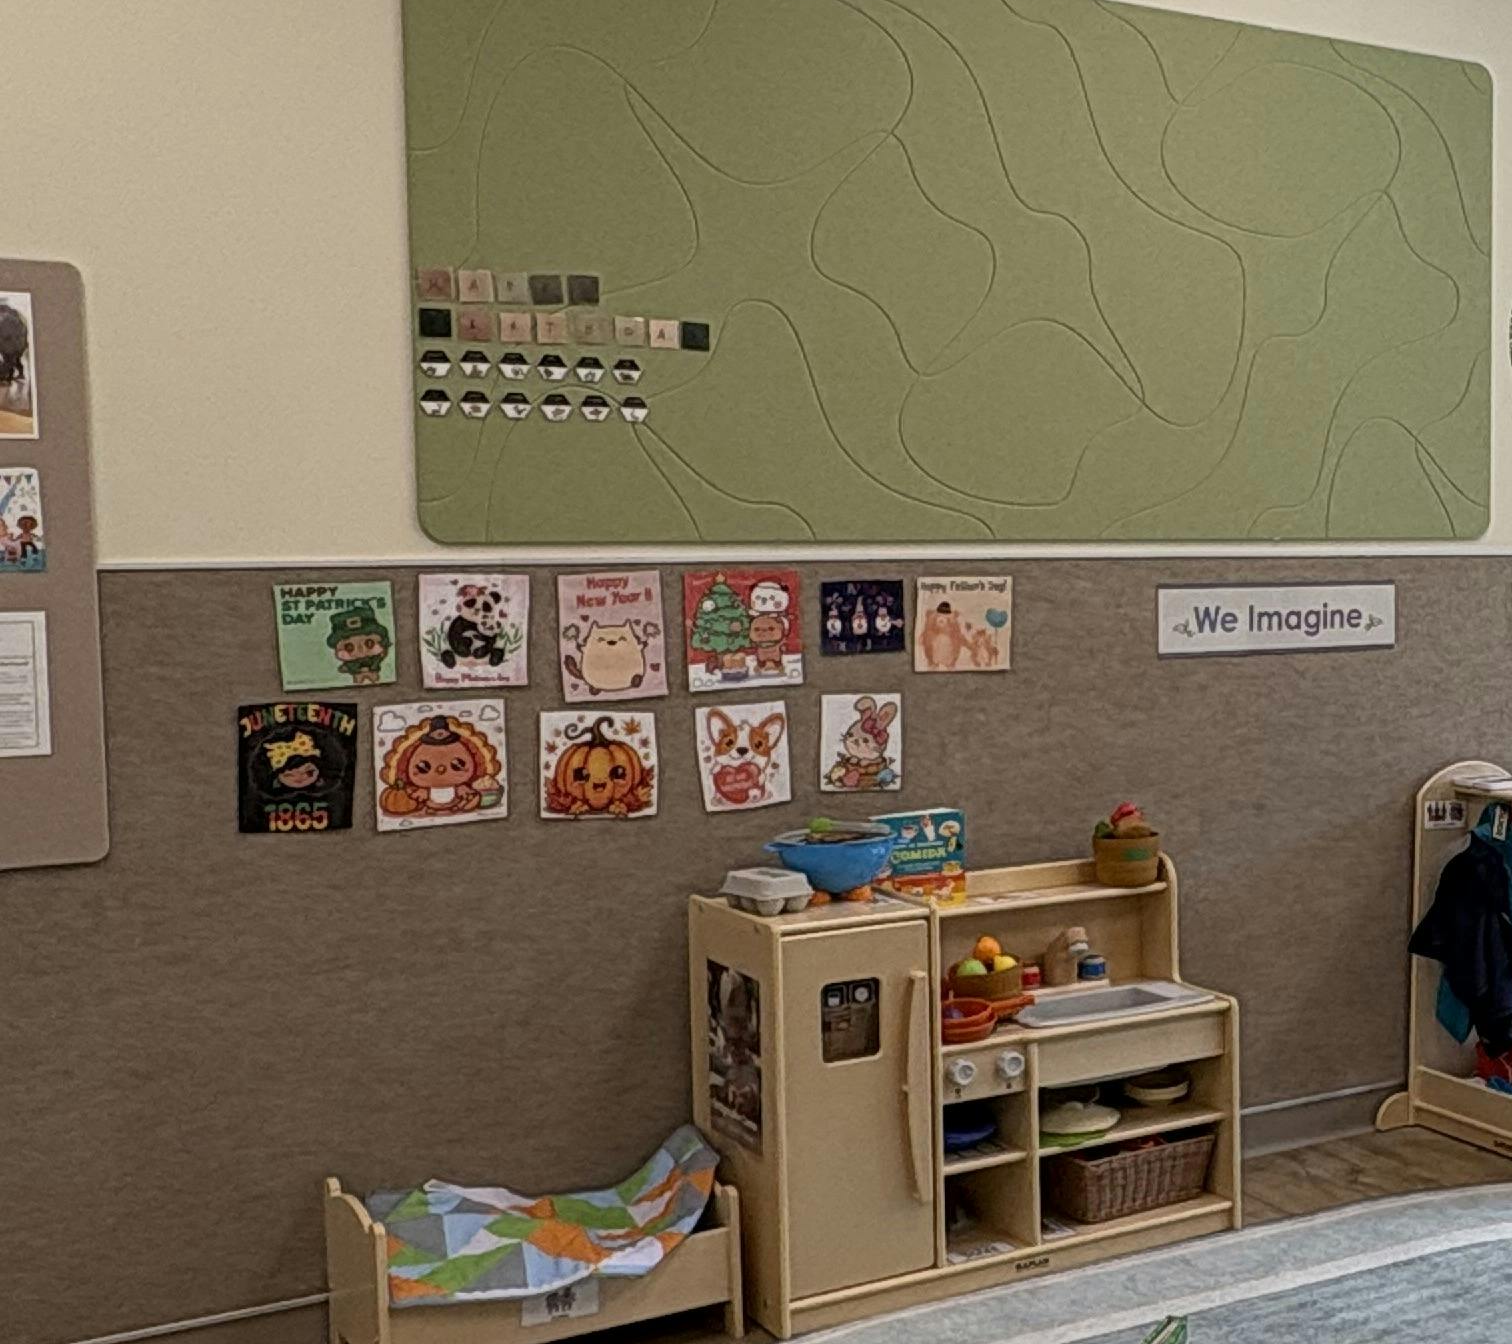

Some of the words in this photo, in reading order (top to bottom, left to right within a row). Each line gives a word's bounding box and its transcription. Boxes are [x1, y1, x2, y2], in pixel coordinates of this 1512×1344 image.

[586, 576, 629, 591] Happy
[280, 586, 338, 598] HAPPY
[576, 594, 606, 608] New
[612, 591, 640, 606] Year
[281, 599, 304, 612] ST
[282, 612, 315, 625] DAY
[1193, 605, 1238, 633] We
[1249, 602, 1362, 637] Imagine
[239, 703, 356, 738] JUNETEENTH
[264, 802, 329, 831] 1865
